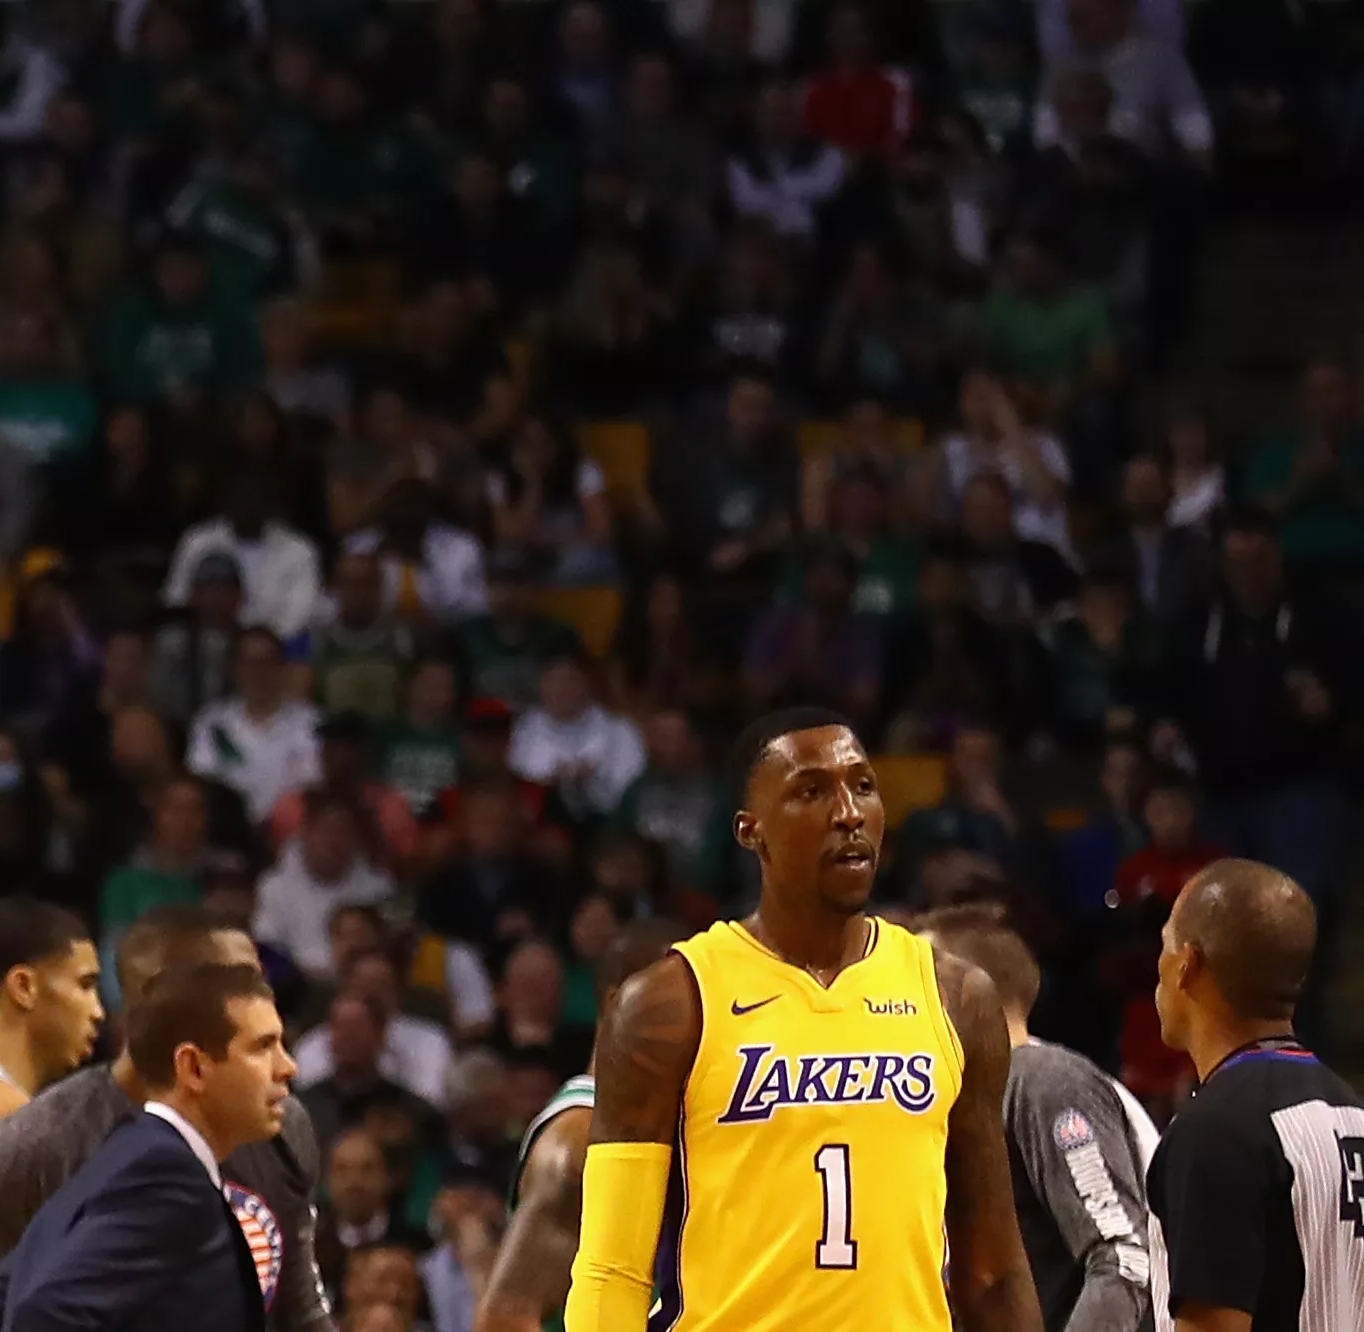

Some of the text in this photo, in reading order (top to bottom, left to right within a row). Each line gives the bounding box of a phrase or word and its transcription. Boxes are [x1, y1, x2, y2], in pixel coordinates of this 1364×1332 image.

[863, 997, 917, 1016] wish
[716, 1042, 937, 1126] LAKERS
[814, 1144, 858, 1271] 1
